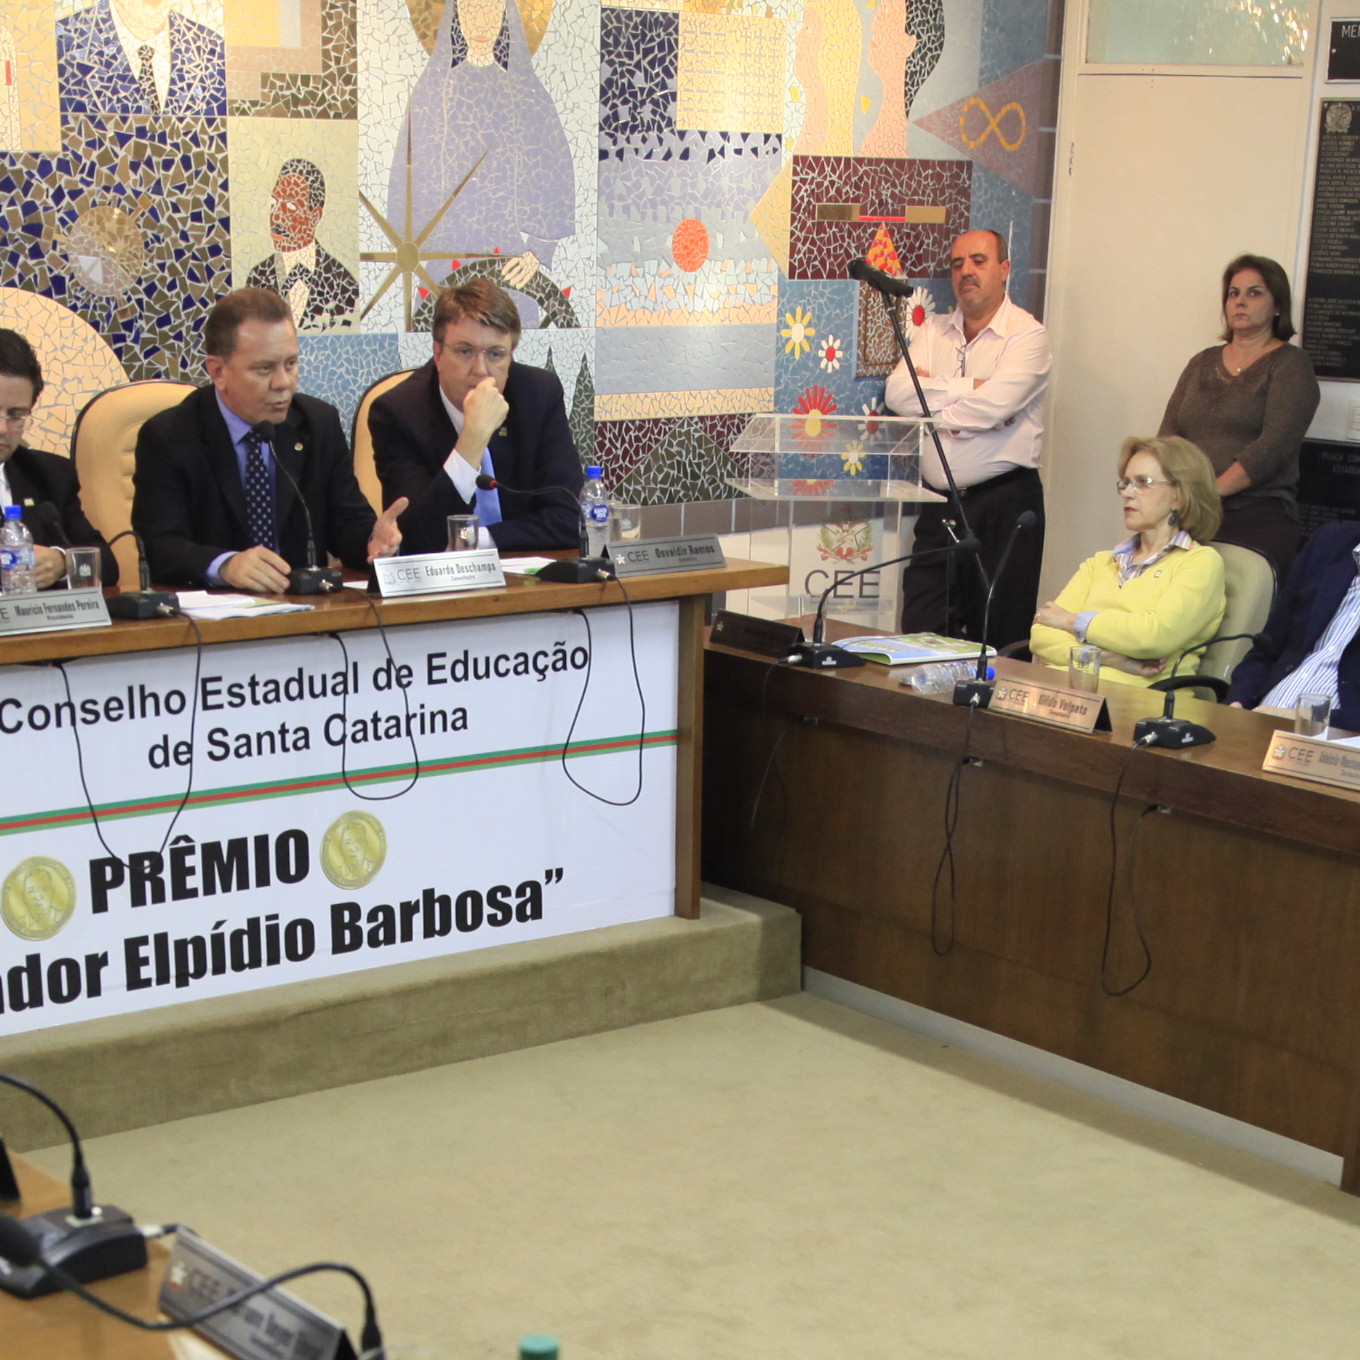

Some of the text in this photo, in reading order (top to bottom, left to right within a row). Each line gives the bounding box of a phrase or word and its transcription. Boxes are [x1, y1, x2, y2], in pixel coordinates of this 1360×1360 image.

[627, 544, 715, 563] CEE Osvaldir Ramos
[396, 562, 496, 581] CEE Eduardo Deschamps
[805, 569, 880, 598] CEE
[43, 601, 76, 614] Fernandes
[77, 599, 100, 611] Pereira
[200, 660, 359, 711] Estadual
[372, 663, 414, 692] de
[427, 641, 589, 687] Educação
[1009, 689, 1030, 703] CEE
[148, 707, 468, 769] de Santa Catarina
[1288, 746, 1314, 763] CEE
[89, 828, 310, 915] PRÊMIO
[124, 912, 316, 991] Elpídio
